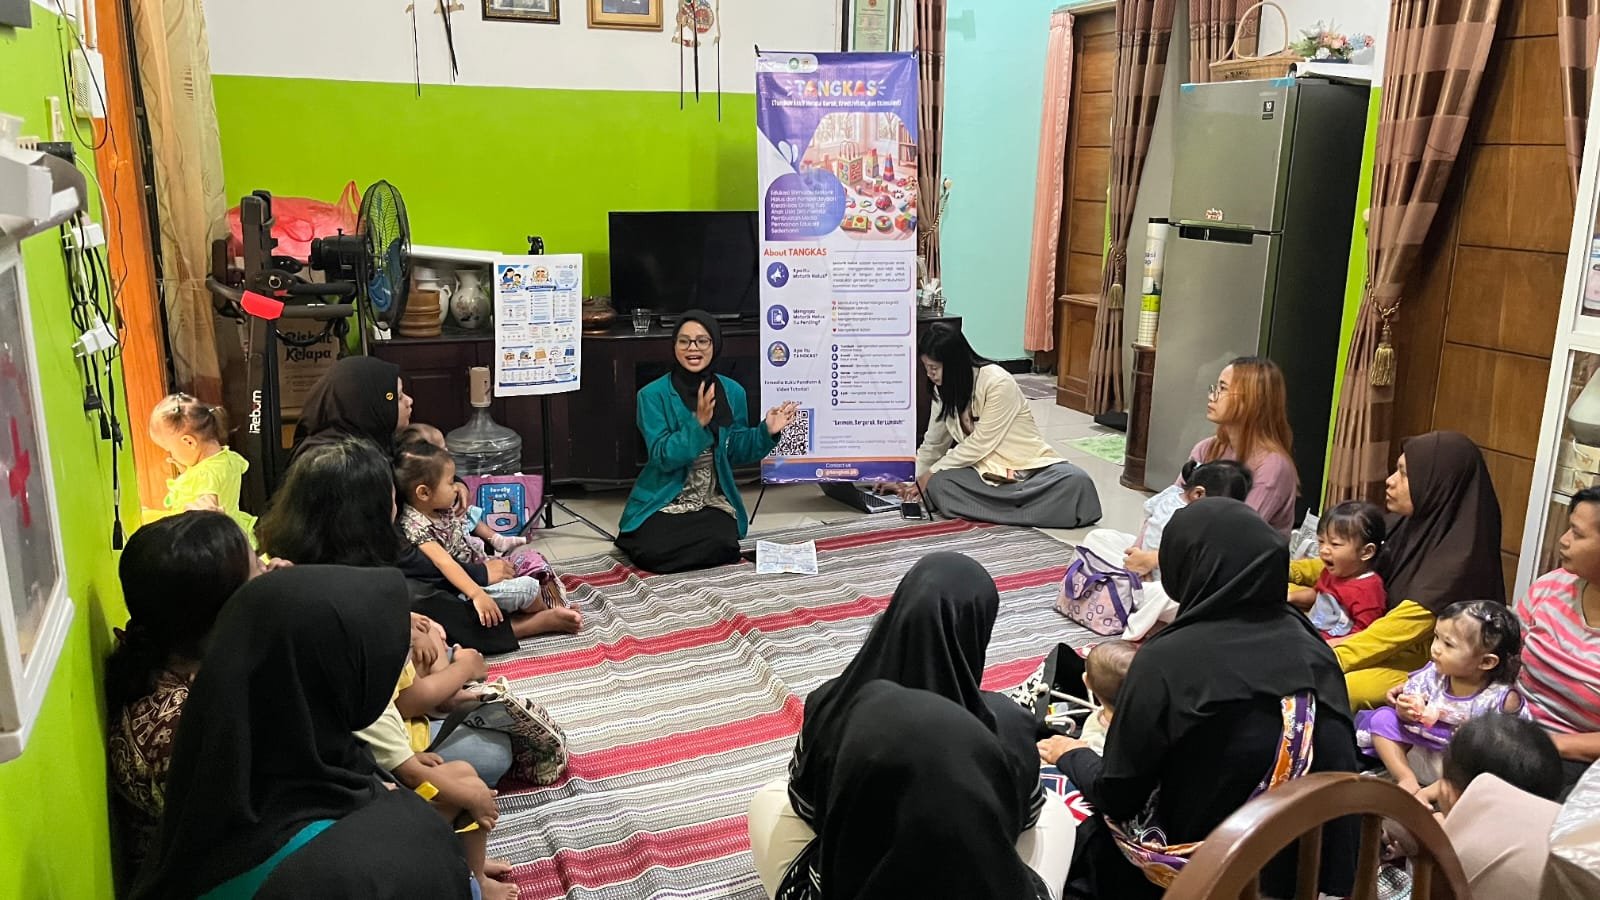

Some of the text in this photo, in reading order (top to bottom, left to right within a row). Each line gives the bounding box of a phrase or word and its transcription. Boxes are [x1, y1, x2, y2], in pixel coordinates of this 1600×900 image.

[795, 79, 878, 97] TANGKAS
[764, 248, 827, 256] About TANGKAS
[285, 347, 331, 363] Kelapa
